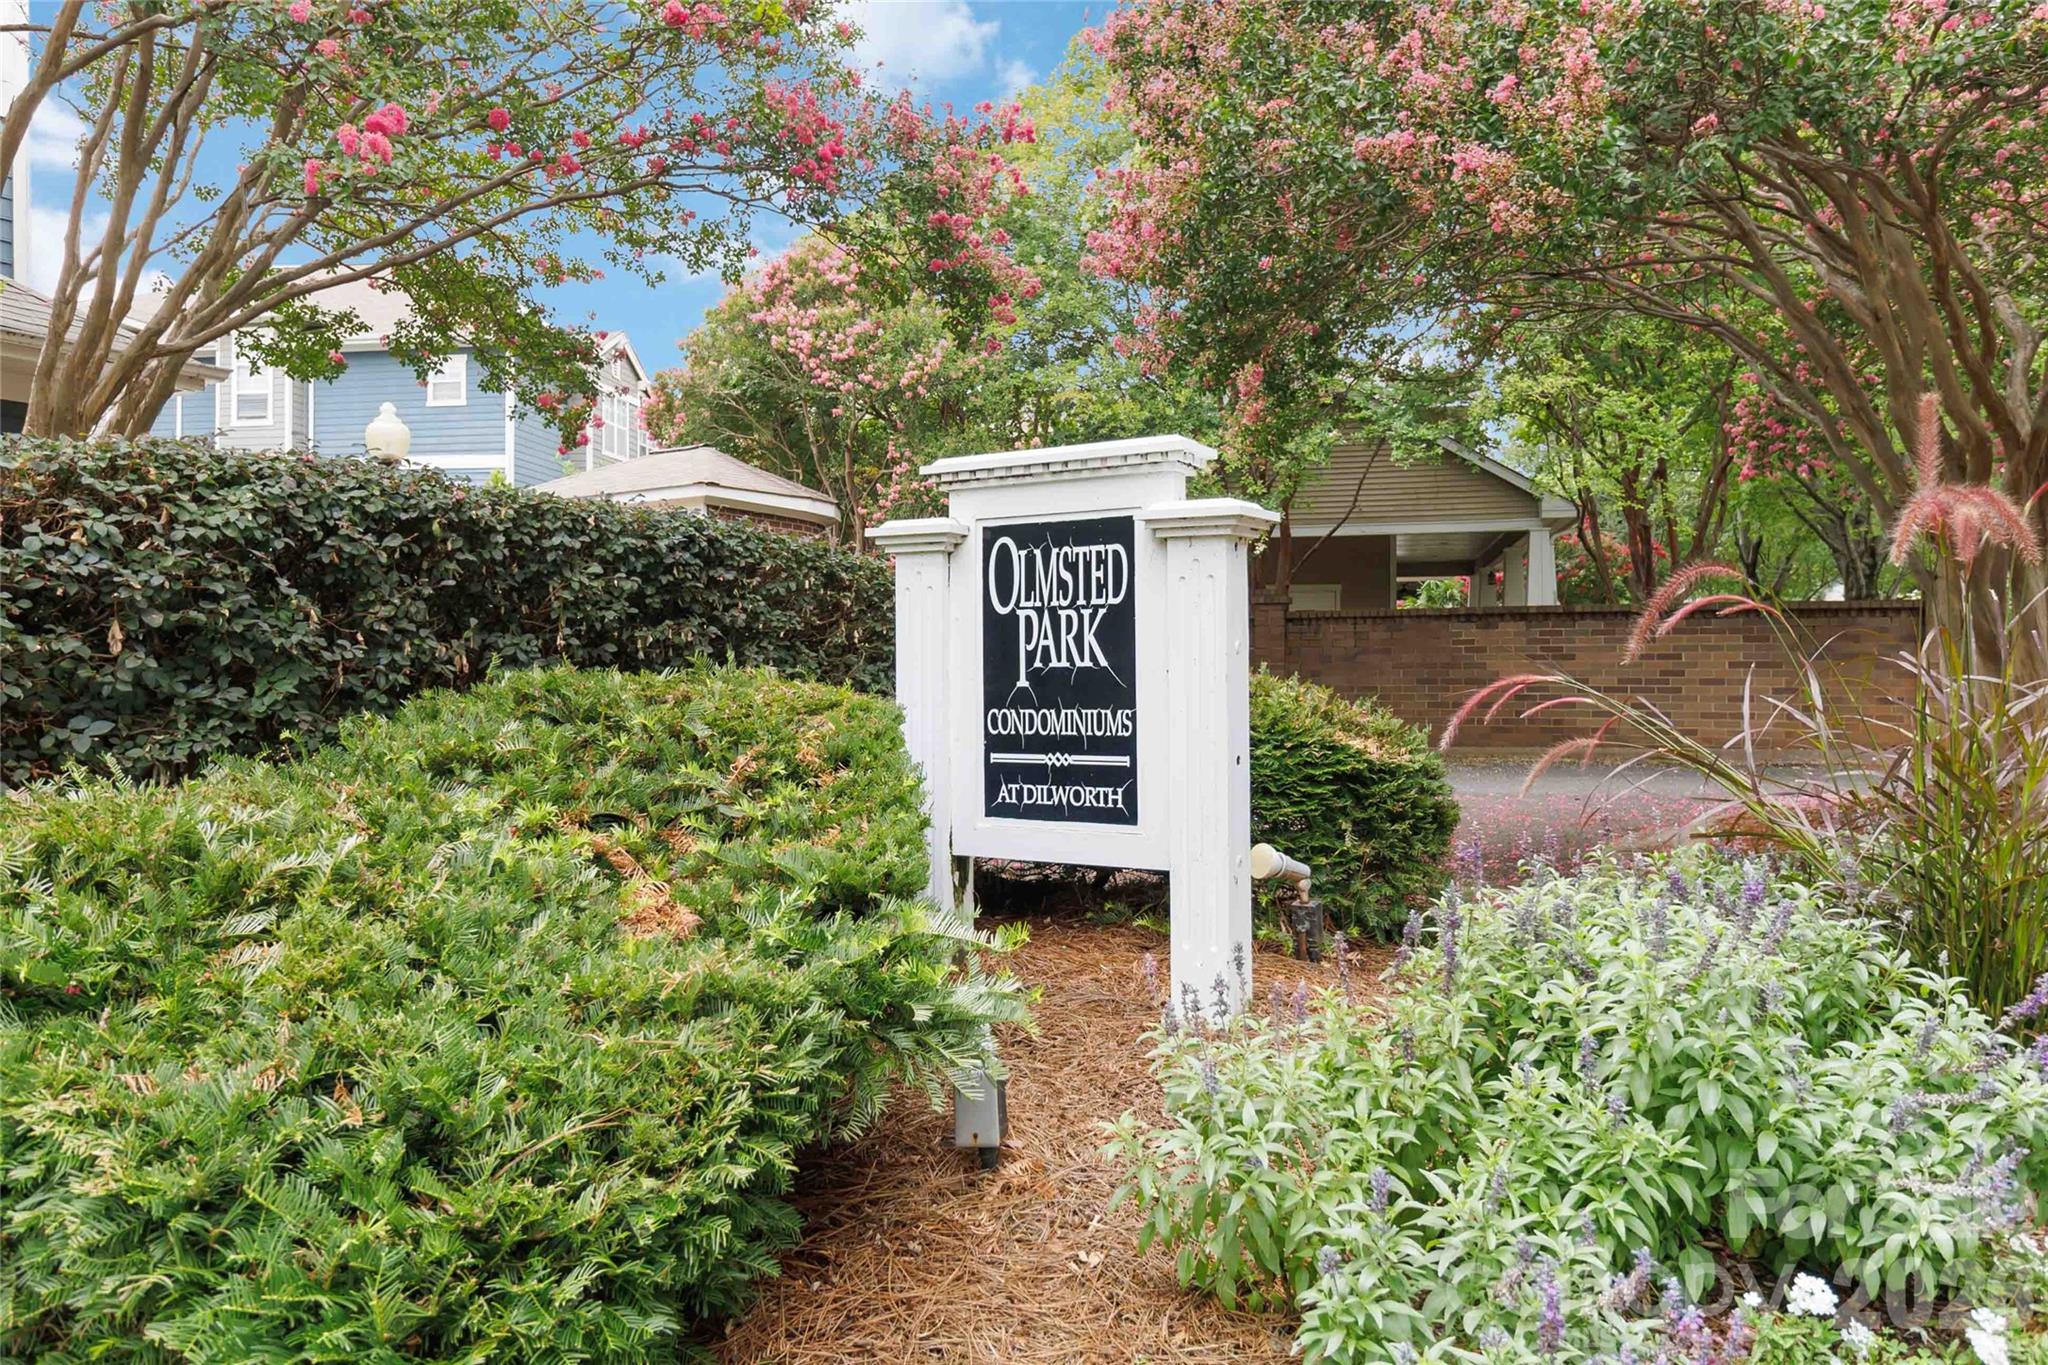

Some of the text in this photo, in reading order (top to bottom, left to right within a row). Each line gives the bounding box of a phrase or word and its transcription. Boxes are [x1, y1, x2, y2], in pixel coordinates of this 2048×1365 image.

[988, 536, 1129, 616] OLMSTED
[1016, 605, 1108, 687] PARK
[987, 707, 1133, 737] CONDOMINIUMS
[998, 783, 1124, 808] AT DILWORTH
